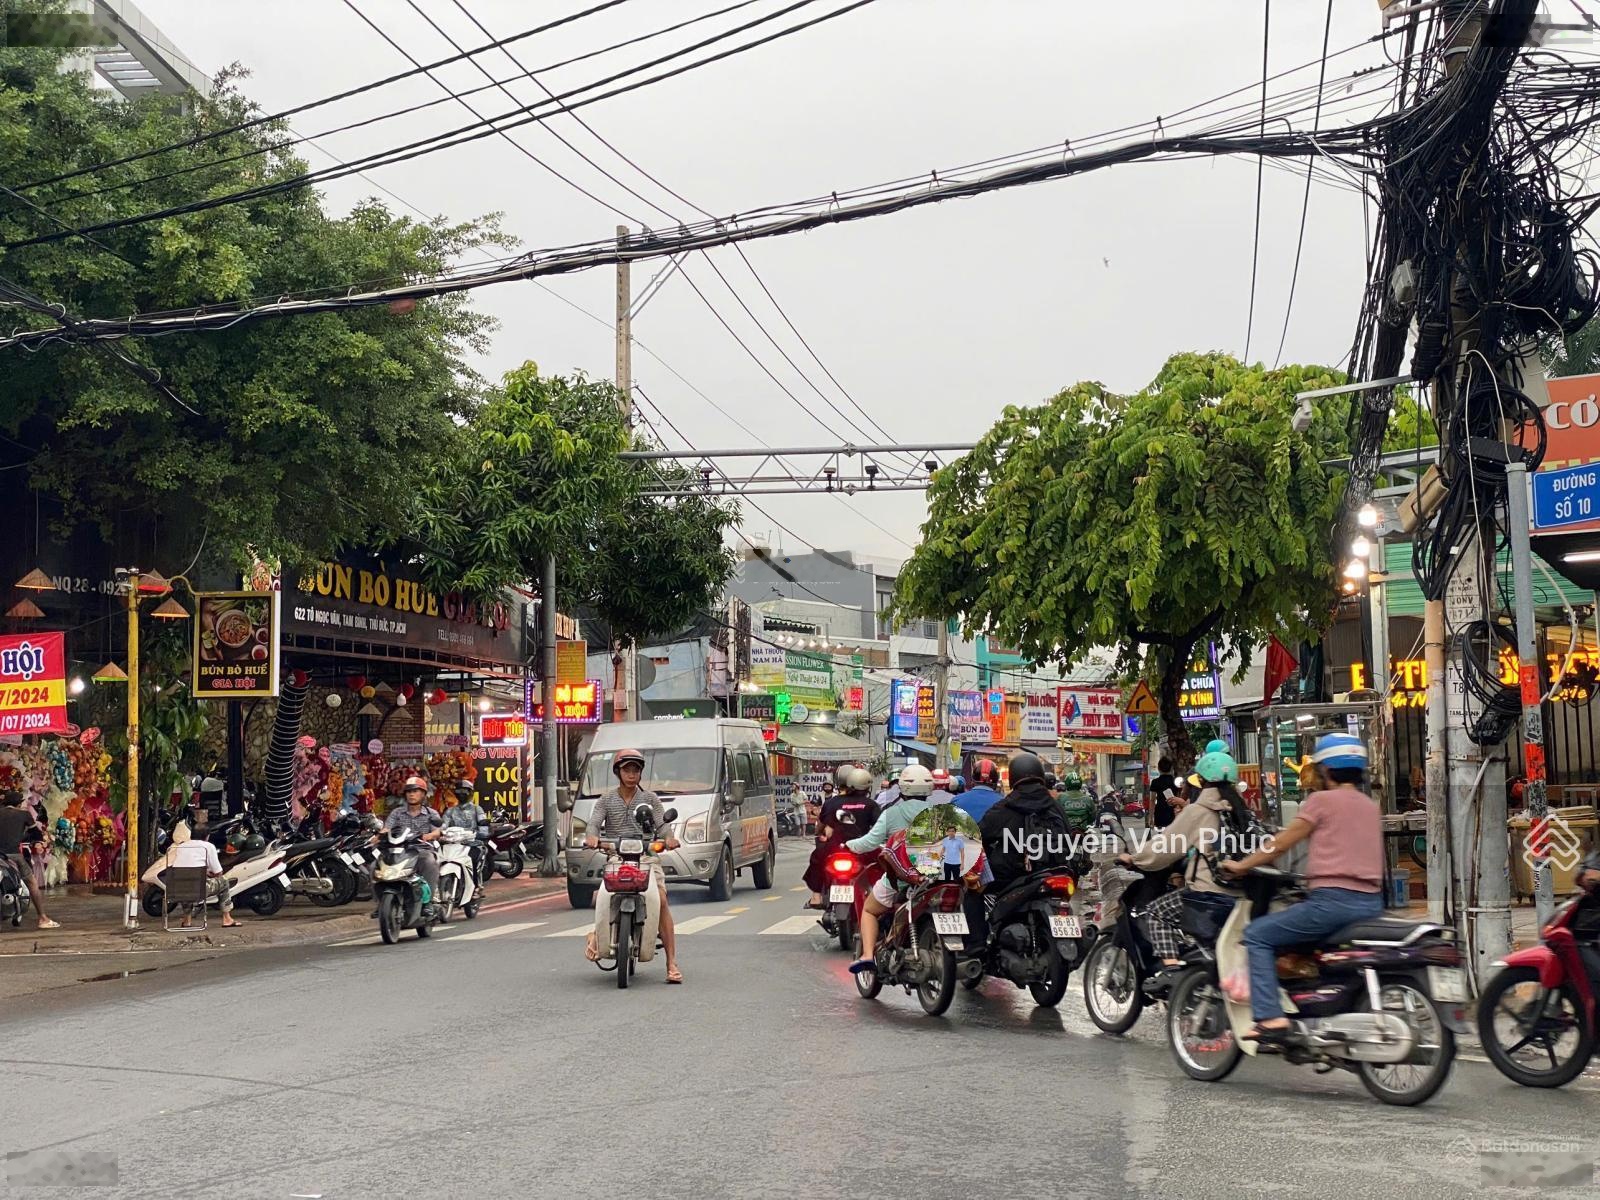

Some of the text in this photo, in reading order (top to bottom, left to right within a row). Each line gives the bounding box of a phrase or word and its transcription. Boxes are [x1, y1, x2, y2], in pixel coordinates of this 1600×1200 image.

[1552, 472, 1596, 492] ĐƯỜNG
[1555, 493, 1591, 519] SỐ 10
[359, 559, 390, 606] BÒ
[294, 606, 306, 621] 622
[3, 643, 44, 680] HỘI
[201, 661, 268, 676] BÚN BÒ HUẾ
[235, 676, 257, 690] HỘI
[1190, 674, 1215, 690] CHỮA
[1190, 690, 1214, 706] KÍNH
[743, 706, 775, 718] HOTEL
[504, 720, 524, 738] TÓC
[960, 724, 978, 733] BÚN
[811, 774, 828, 783] NHÀ
[801, 784, 824, 793] THUỐ
[1064, 800, 1087, 810] Grab
